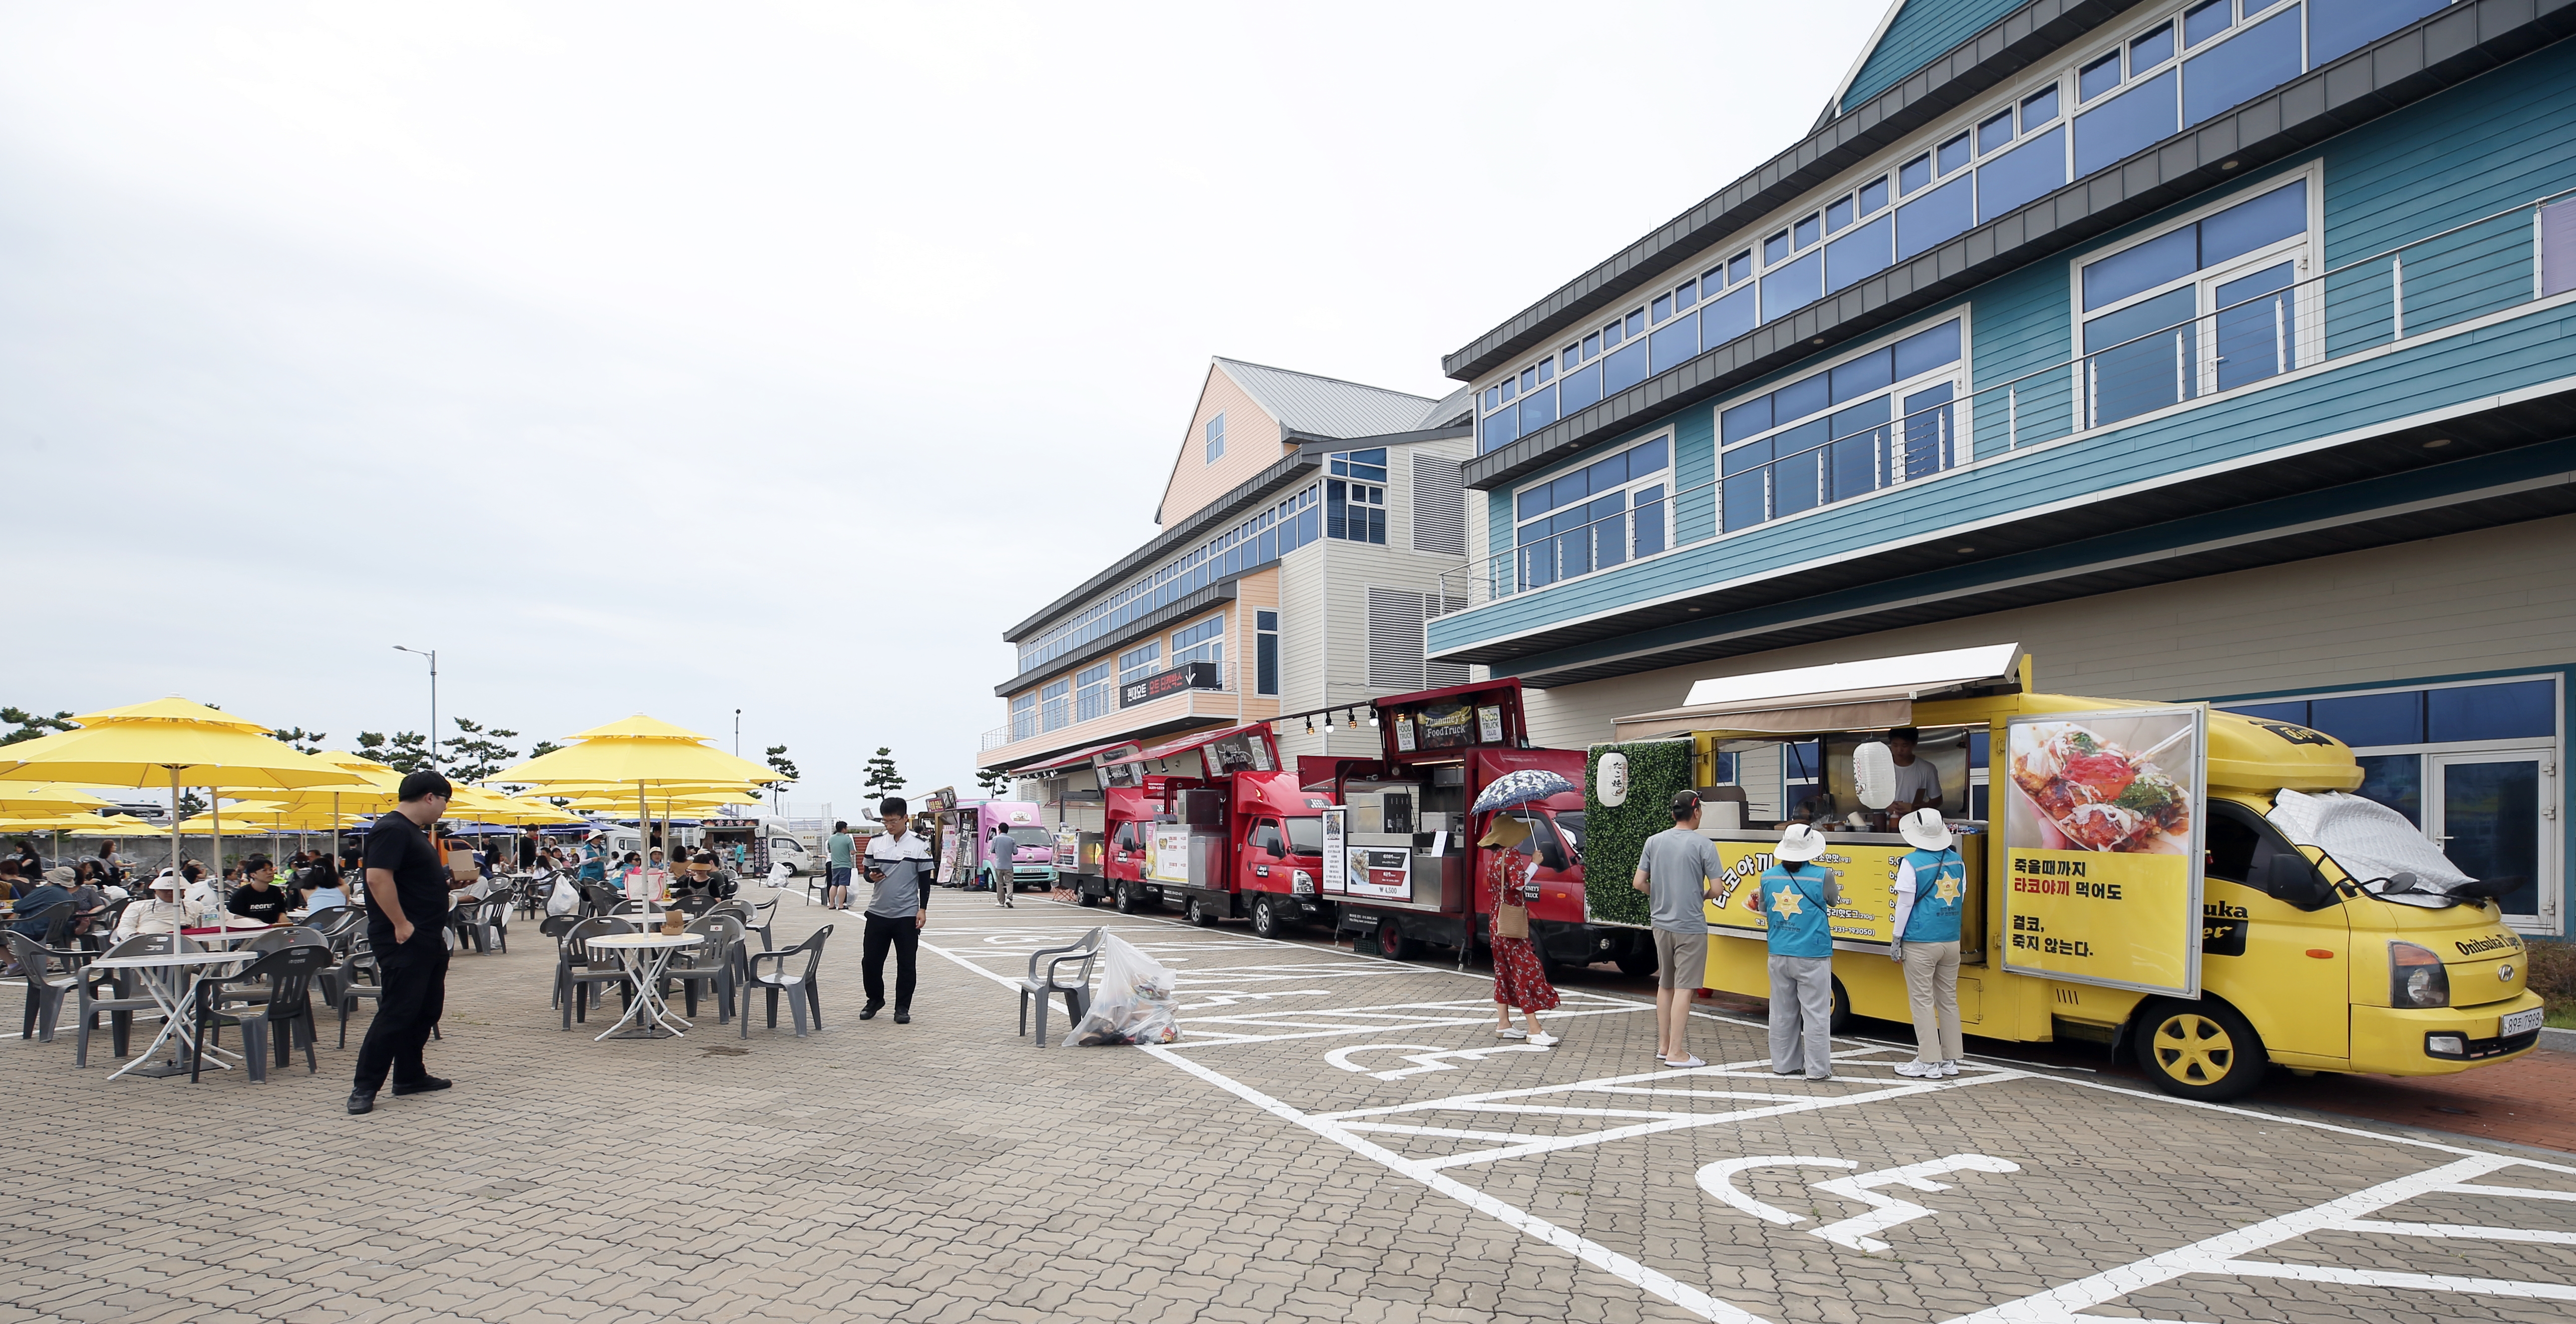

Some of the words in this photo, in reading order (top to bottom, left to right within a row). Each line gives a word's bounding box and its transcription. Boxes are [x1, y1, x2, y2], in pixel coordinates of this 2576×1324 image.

[1127, 683, 1147, 702] 현대요트
[1149, 679, 1160, 695] 요트
[1160, 672, 1183, 691] 티켓박스
[1481, 713, 1498, 723] FOOD
[1482, 722, 1499, 730] TRUCK
[1398, 725, 1411, 733] FOOD
[1427, 725, 1465, 738] FoodTruck
[2014, 858, 2086, 877] 죽을때까지
[2014, 877, 2070, 896] 타코야끼
[2076, 881, 2122, 900] 먹어도
[2203, 900, 2248, 918] uka
[2013, 915, 2045, 932] 결코,
[2202, 926, 2233, 939] er
[2012, 933, 2039, 951] 죽지
[2045, 937, 2094, 957] 않는다.
[2455, 935, 2505, 956] Onitsuka
